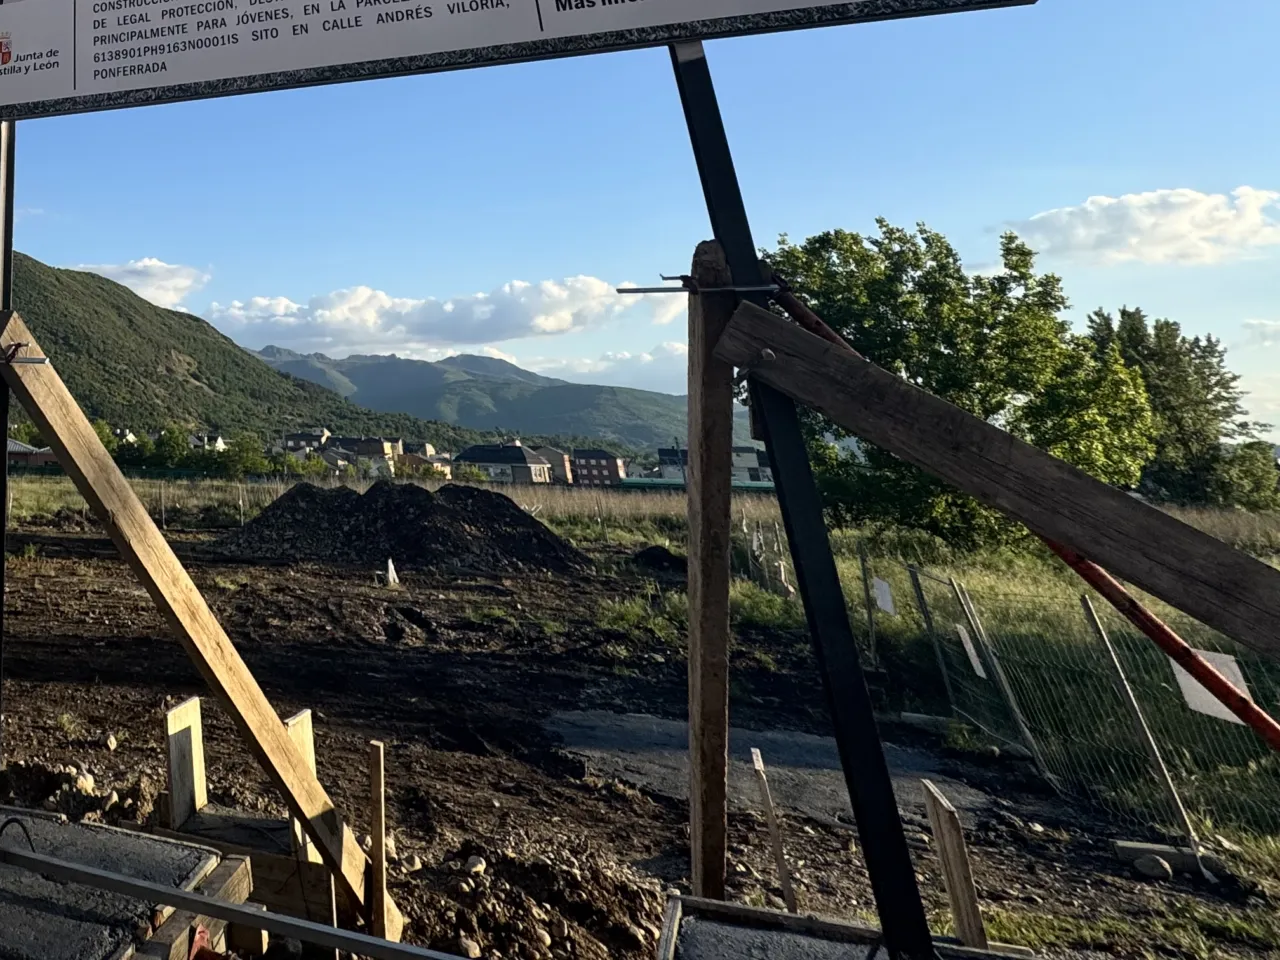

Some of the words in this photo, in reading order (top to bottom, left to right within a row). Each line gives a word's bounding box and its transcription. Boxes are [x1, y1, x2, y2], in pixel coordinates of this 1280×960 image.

[93, 18, 106, 29] DE
[117, 12, 151, 26] LEGAL
[93, 23, 187, 46] PRINCIPALMENTE
[197, 17, 226, 31] PARA
[236, 8, 297, 25] JÓVENES,
[303, 3, 319, 15] EN
[330, 0, 345, 11] LA
[94, 33, 238, 62] 6138901PH9163N0001IS
[252, 27, 278, 41] SITO
[292, 23, 308, 35] EN
[322, 15, 362, 31] CALLE
[377, 5, 432, 24] ANDRÉS
[14, 52, 42, 62] Junta
[45, 49, 59, 57] de
[33, 61, 59, 71] León
[94, 61, 167, 79] PONFERRADA
